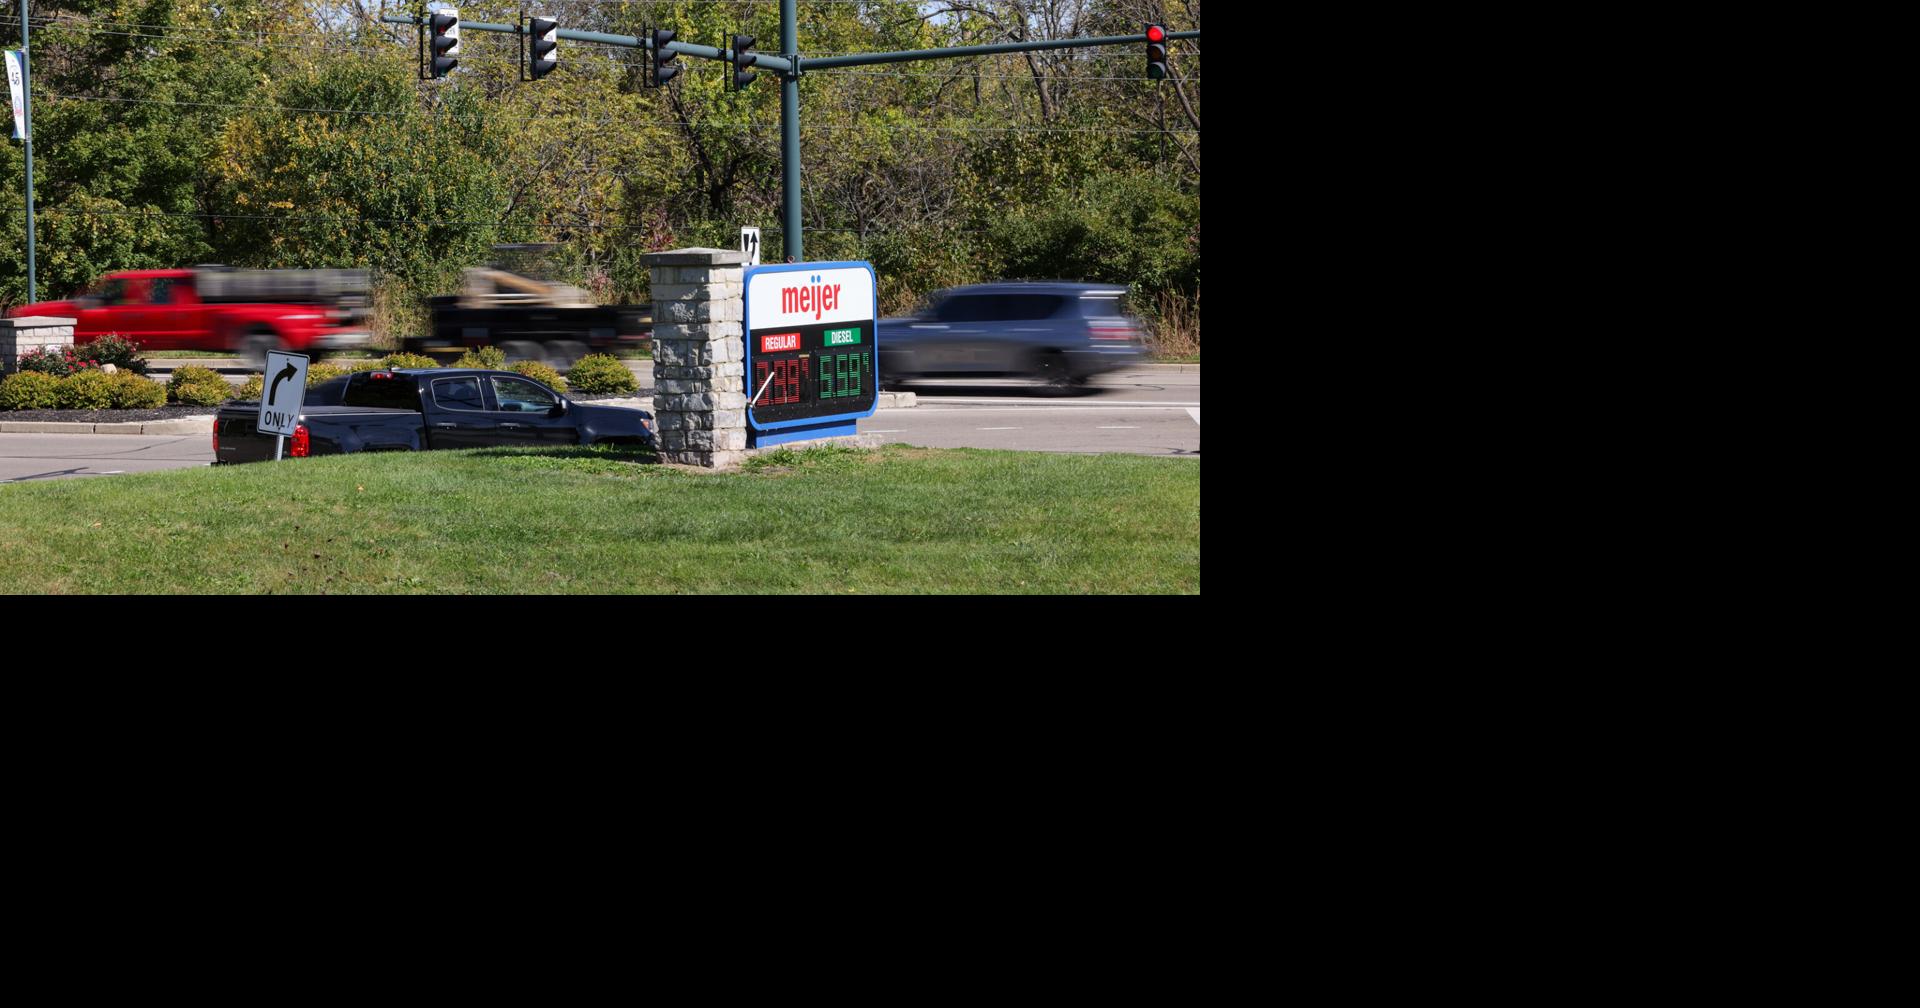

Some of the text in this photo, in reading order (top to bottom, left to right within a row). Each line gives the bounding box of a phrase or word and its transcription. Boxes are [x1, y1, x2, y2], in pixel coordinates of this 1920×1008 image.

[782, 275, 840, 320] meijer
[765, 336, 796, 350] REGULAR
[831, 330, 853, 344] DIESEL
[264, 410, 294, 428] ONLY
